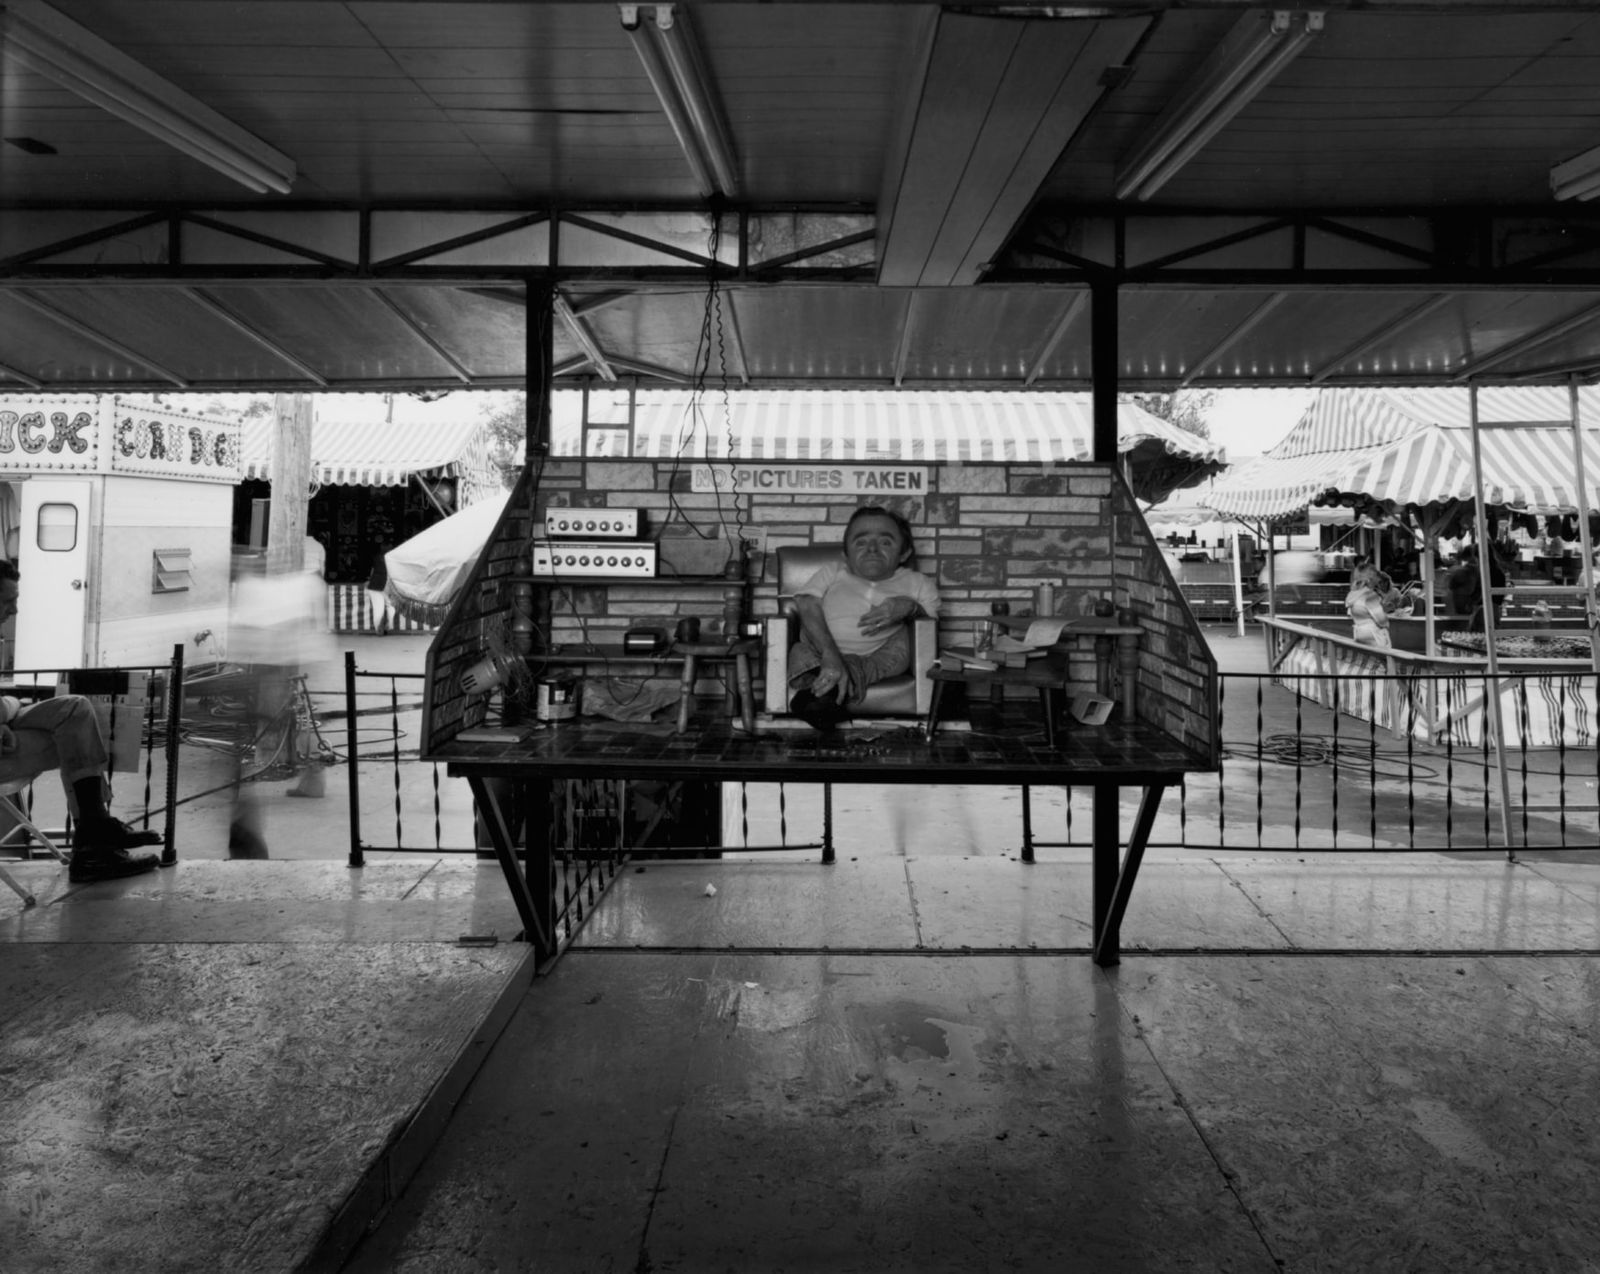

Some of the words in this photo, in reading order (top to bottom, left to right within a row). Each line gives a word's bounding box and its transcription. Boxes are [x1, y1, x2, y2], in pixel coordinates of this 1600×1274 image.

[118, 417, 185, 462] CORN
[188, 427, 236, 468] DOGS
[695, 469, 728, 488] NO
[736, 469, 842, 489] PICTURES
[853, 470, 921, 490] TAKEN
